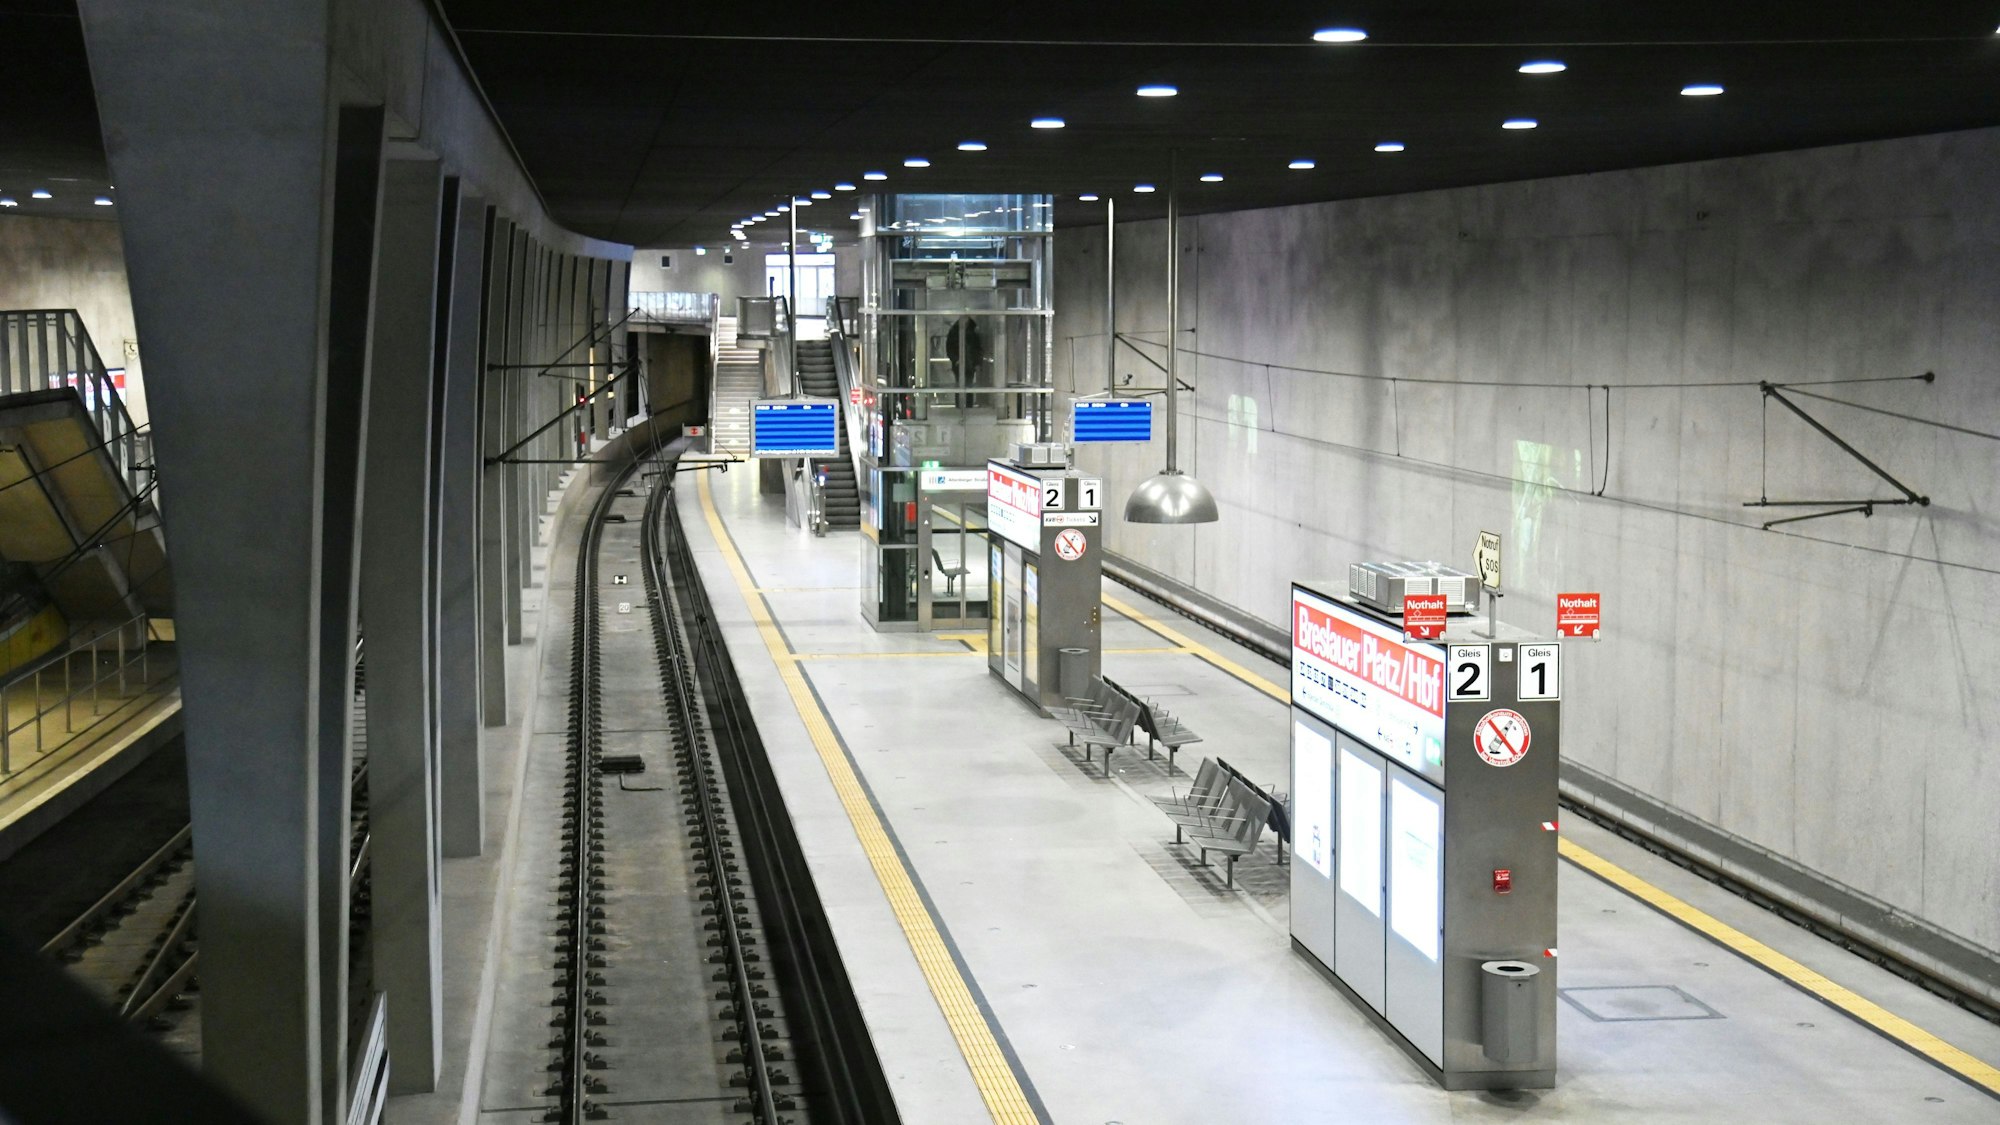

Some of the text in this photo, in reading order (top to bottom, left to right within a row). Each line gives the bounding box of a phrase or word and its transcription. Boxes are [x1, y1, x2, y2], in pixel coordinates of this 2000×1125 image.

[1046, 489, 1059, 507] 2
[1085, 488, 1094, 506] 1
[1481, 534, 1499, 551] Notruf
[1485, 558, 1499, 573] SOS
[1407, 600, 1444, 610] Nothalt
[1559, 598, 1597, 608] Nothalt
[1299, 605, 1361, 672] Breslauer
[1457, 649, 1481, 658] Gleis
[1528, 648, 1552, 657] Gleis
[1456, 662, 1481, 696] 2
[1530, 662, 1546, 695] 1
